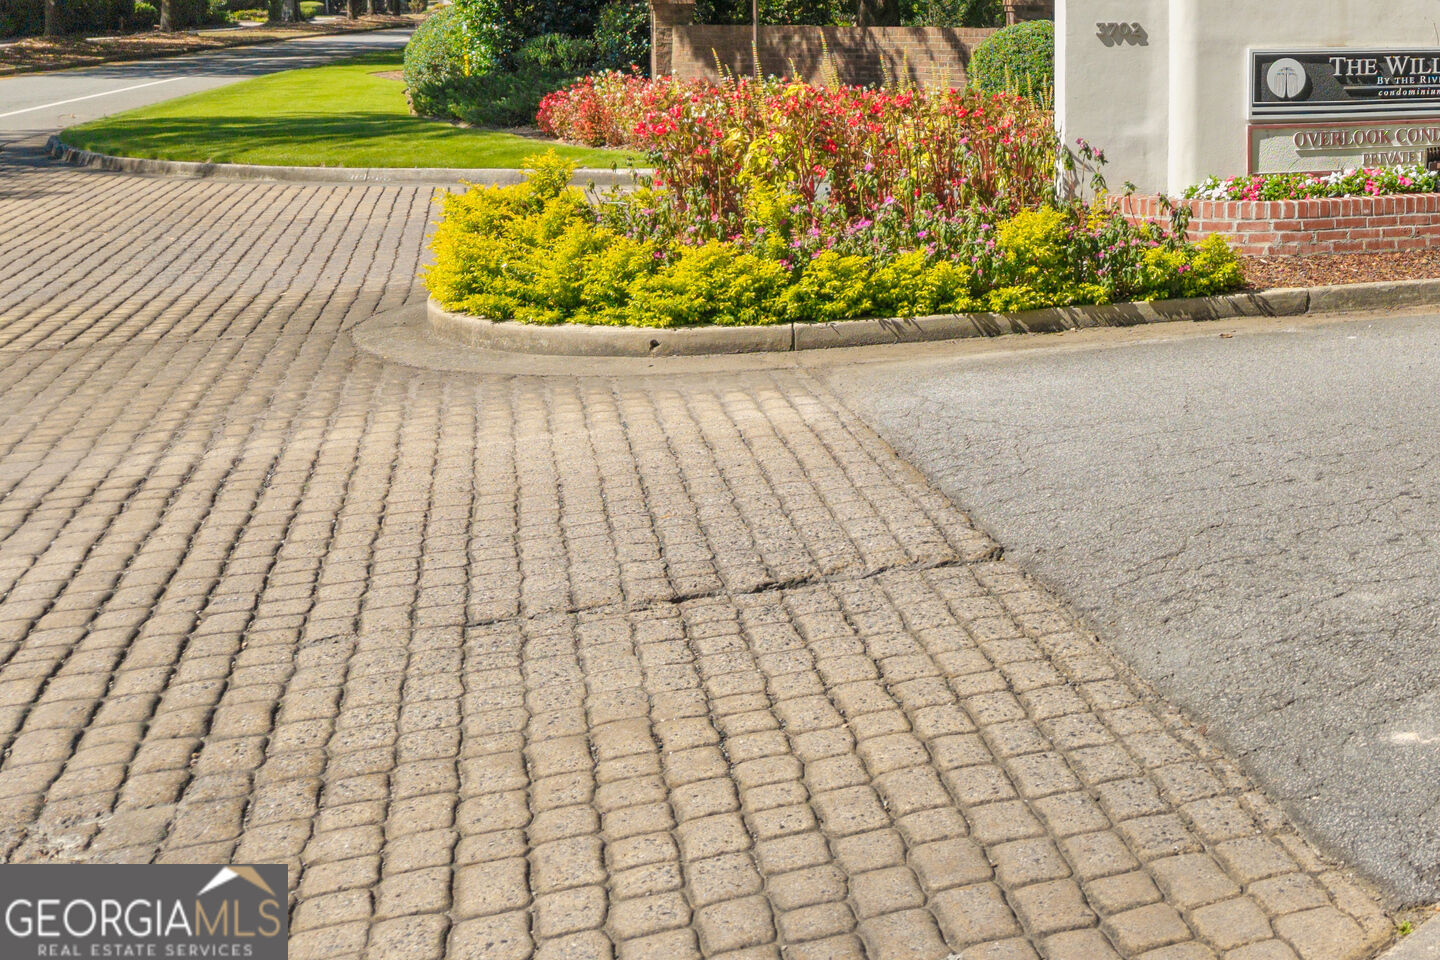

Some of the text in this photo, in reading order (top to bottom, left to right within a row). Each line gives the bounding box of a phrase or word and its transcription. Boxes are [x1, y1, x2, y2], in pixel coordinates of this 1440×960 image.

[1329, 57, 1378, 76] THE
[1377, 76, 1389, 85] BY
[1293, 128, 1392, 148] OVERLOOK
[1362, 151, 1416, 165] PRIVATE
